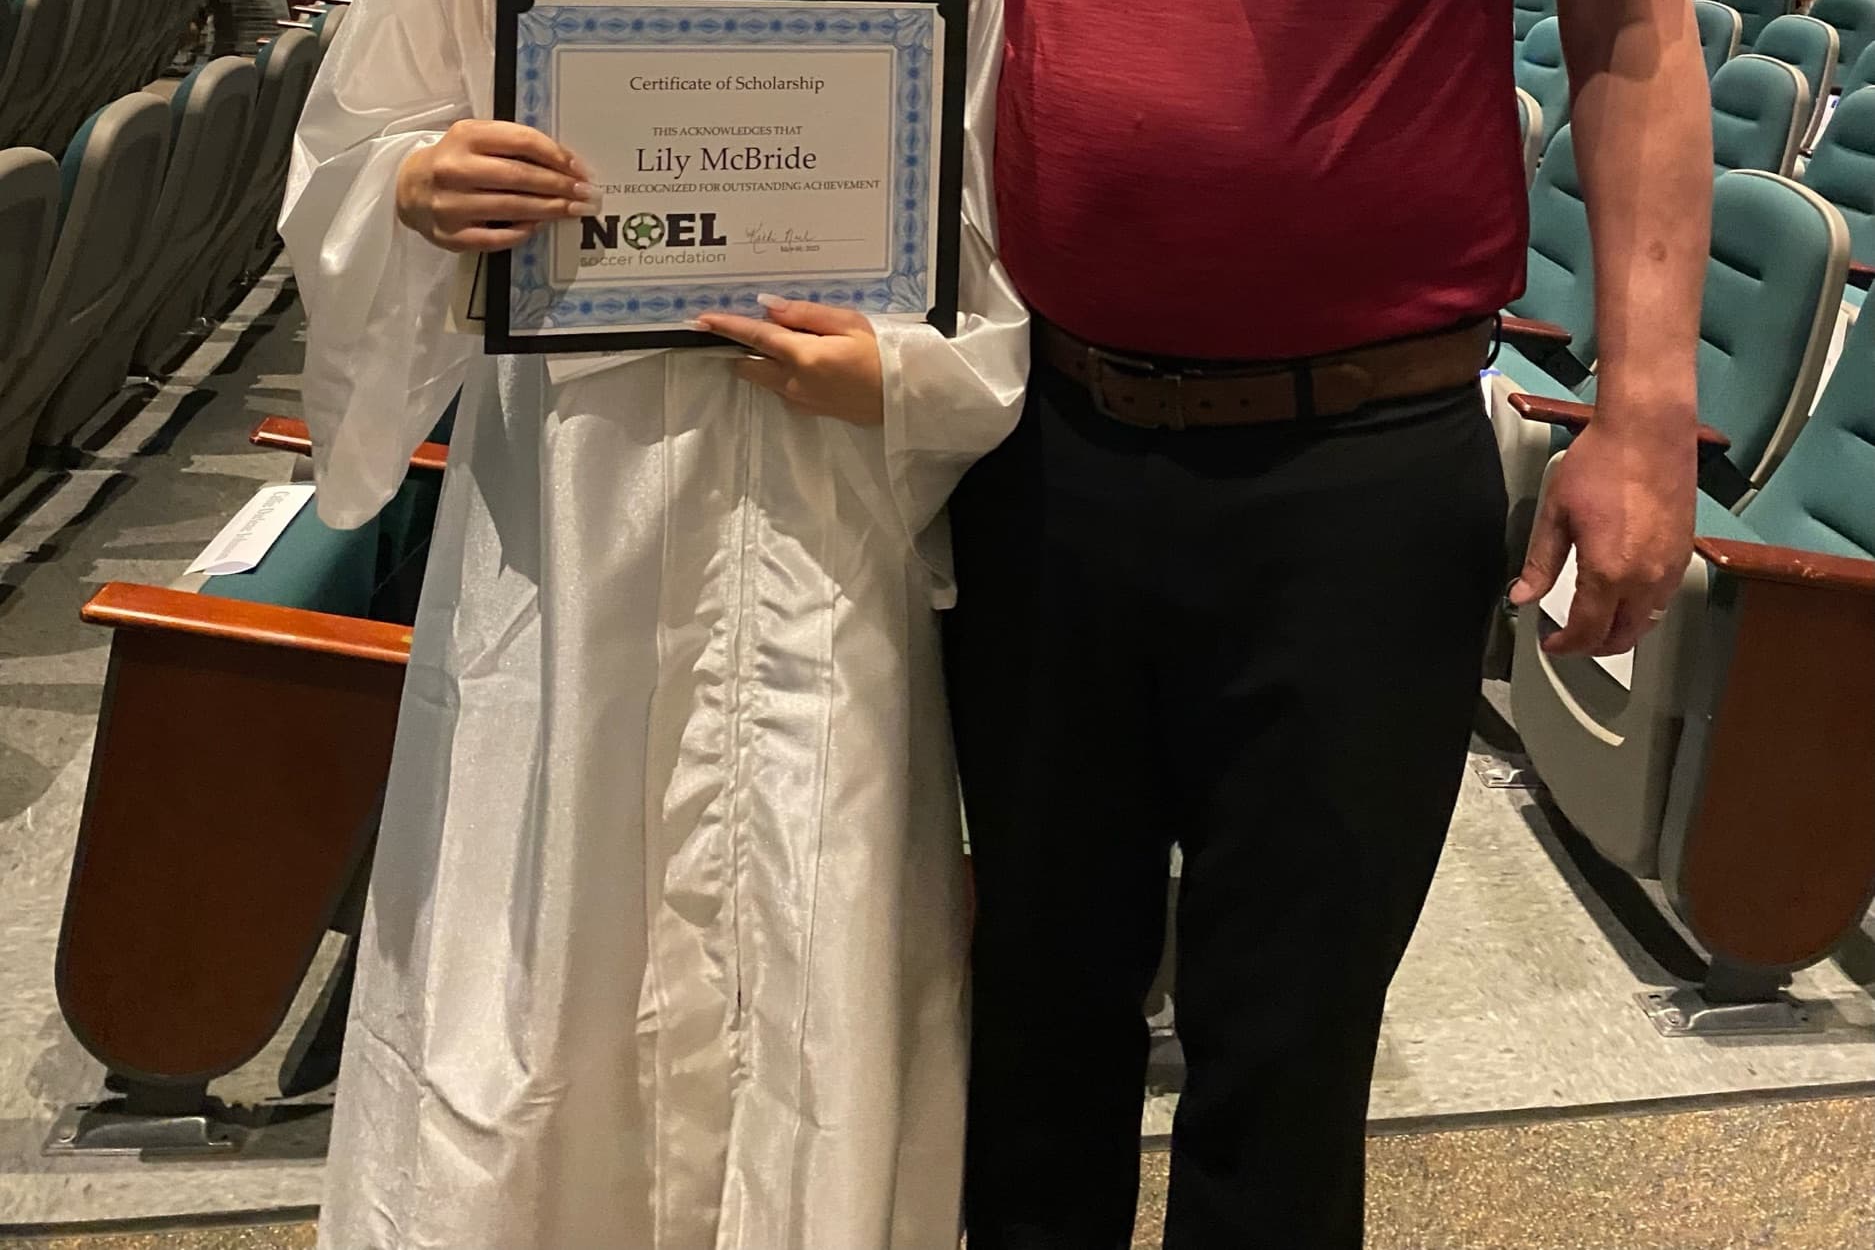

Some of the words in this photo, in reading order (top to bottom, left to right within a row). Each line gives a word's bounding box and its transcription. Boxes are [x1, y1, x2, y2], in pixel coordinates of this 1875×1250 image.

[629, 76, 712, 91] Certificate
[715, 76, 733, 91] of
[735, 75, 825, 94] Scholarship
[652, 126, 678, 137] THIS
[679, 126, 773, 137] ACKNOWLEDGES
[773, 125, 803, 136] THAT
[635, 147, 692, 180] Lily
[699, 146, 817, 171] McBride
[599, 184, 622, 194] EN
[623, 183, 697, 194] RECOGNIZED
[699, 182, 722, 192] FOR
[722, 181, 801, 192] OUTSTANDING
[803, 179, 881, 191] ACHIEVEMENT
[580, 212, 728, 250] NOEL
[579, 254, 633, 268] soccer
[638, 251, 727, 266] foundation
